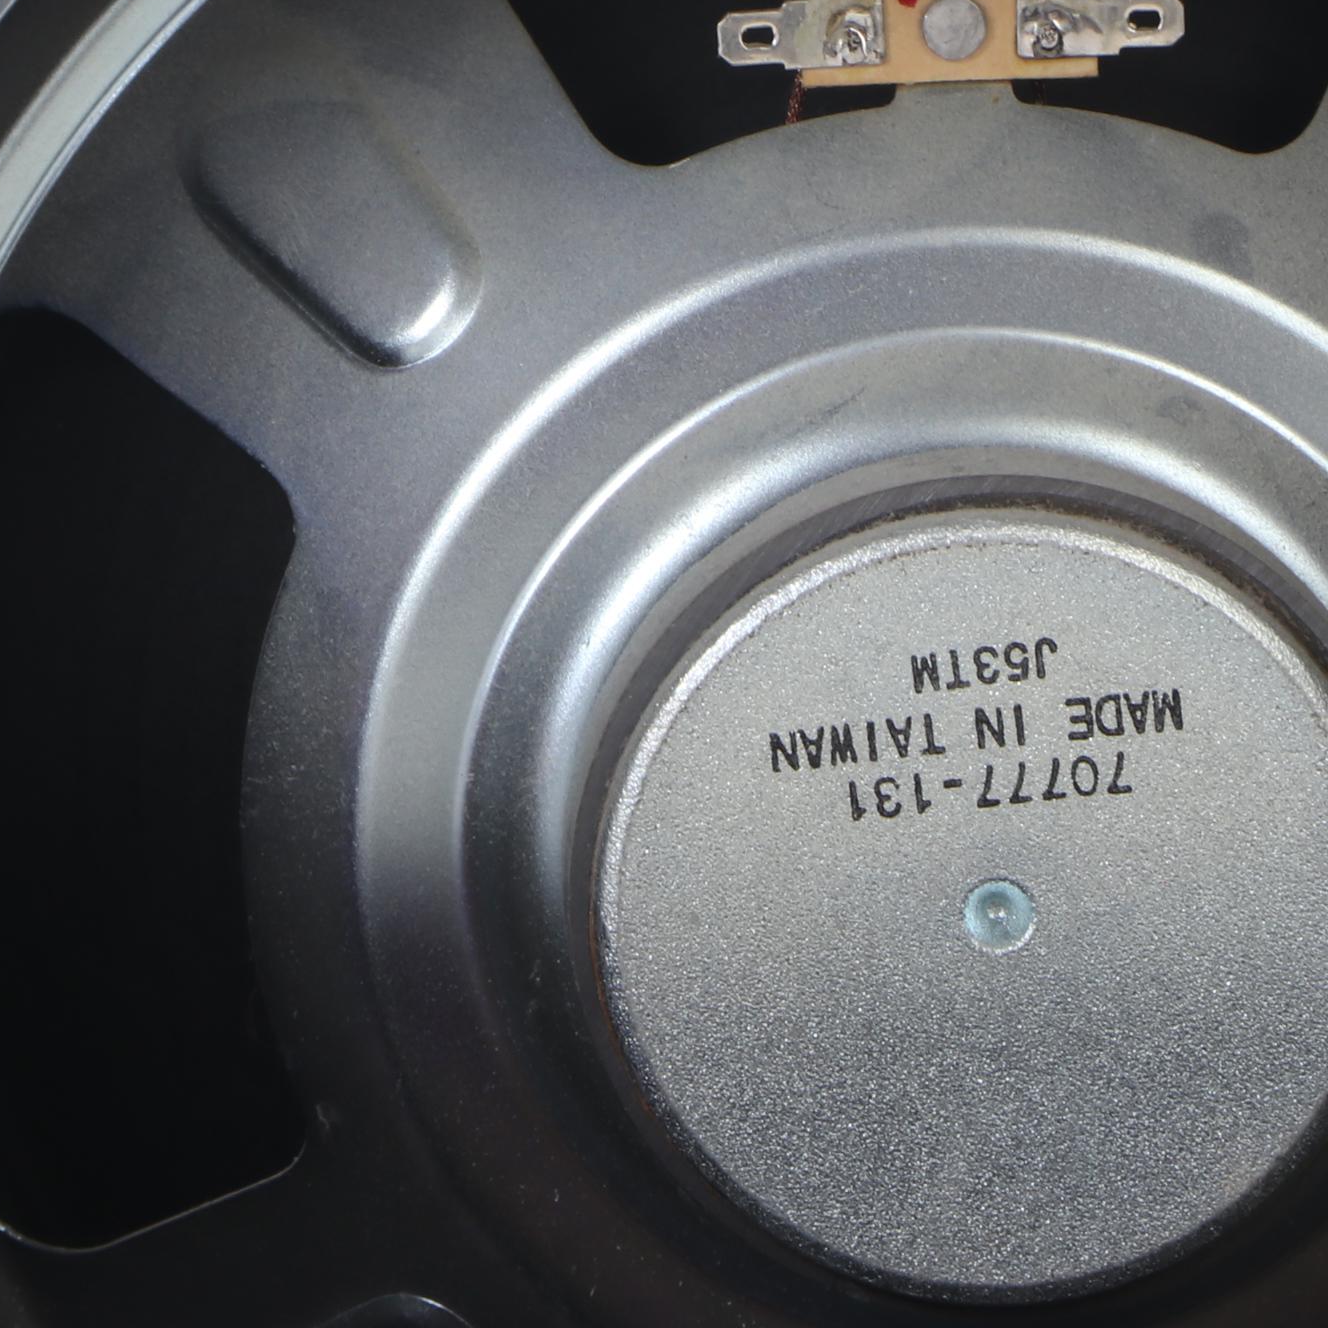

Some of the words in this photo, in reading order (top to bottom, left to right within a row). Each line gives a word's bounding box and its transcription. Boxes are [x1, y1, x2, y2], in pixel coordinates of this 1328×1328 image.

[910, 636, 1058, 694] J53TM
[974, 703, 1026, 750] IN
[1065, 688, 1184, 741] MADE
[769, 713, 947, 773] TAIWAN
